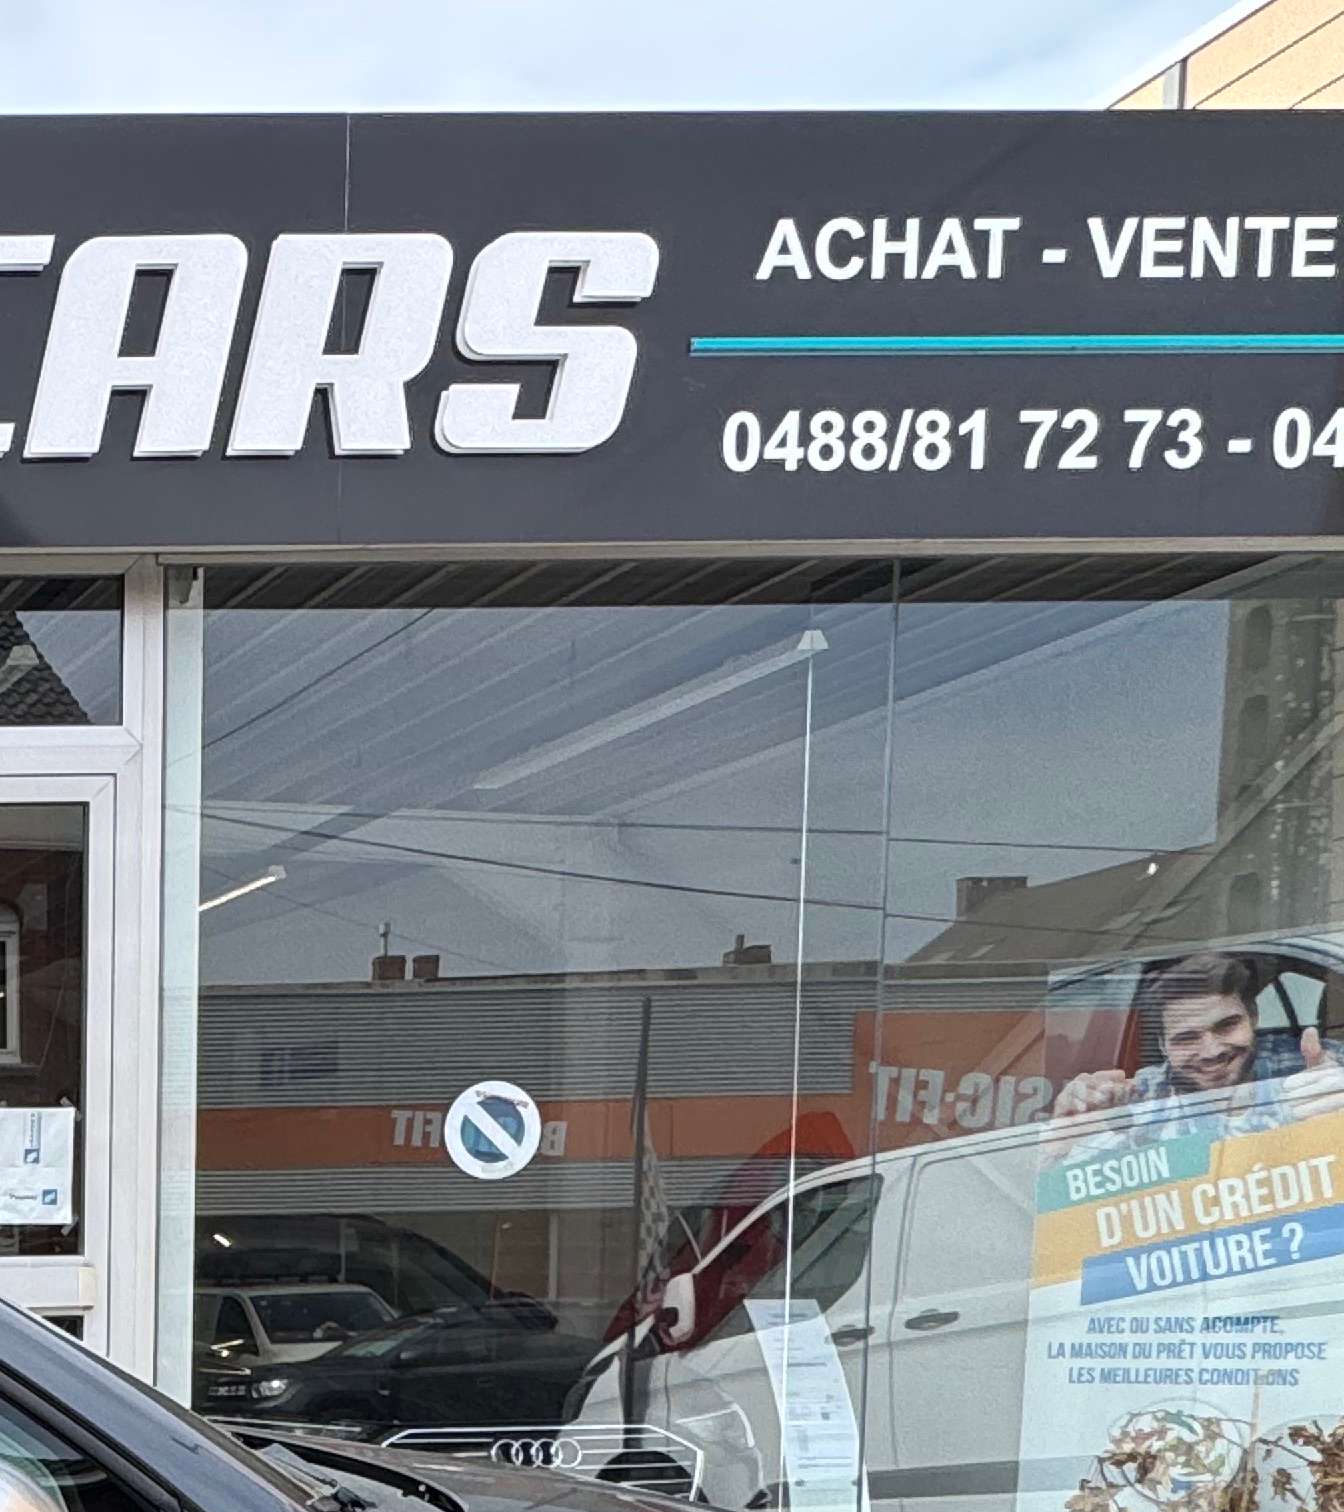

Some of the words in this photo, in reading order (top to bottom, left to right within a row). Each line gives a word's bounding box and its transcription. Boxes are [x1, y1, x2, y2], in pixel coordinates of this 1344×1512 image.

[754, 216, 1022, 280] ACHAT
[1087, 215, 1338, 279] VENTE
[721, 406, 986, 472] 0488/81
[1018, 408, 1098, 470] 72
[1122, 407, 1203, 470] 73
[1066, 1146, 1171, 1202] BESOIN
[1095, 1188, 1186, 1248] D'UN
[1192, 1154, 1337, 1226] CRÉDIT
[1125, 1227, 1277, 1291] VOITURE
[1047, 1341, 1066, 1360] LA
[1070, 1341, 1128, 1360] MAISON
[1132, 1341, 1153, 1360] DU
[1156, 1338, 1197, 1360] PRÊT
[1201, 1341, 1248, 1360] VOUS
[1251, 1341, 1329, 1361] PROPOSE
[1086, 1317, 1126, 1335] AVEC
[1129, 1317, 1150, 1335] OU
[1153, 1316, 1195, 1334] SANS
[1068, 1366, 1096, 1385] LES
[1099, 1367, 1195, 1386] MEILLEURES
